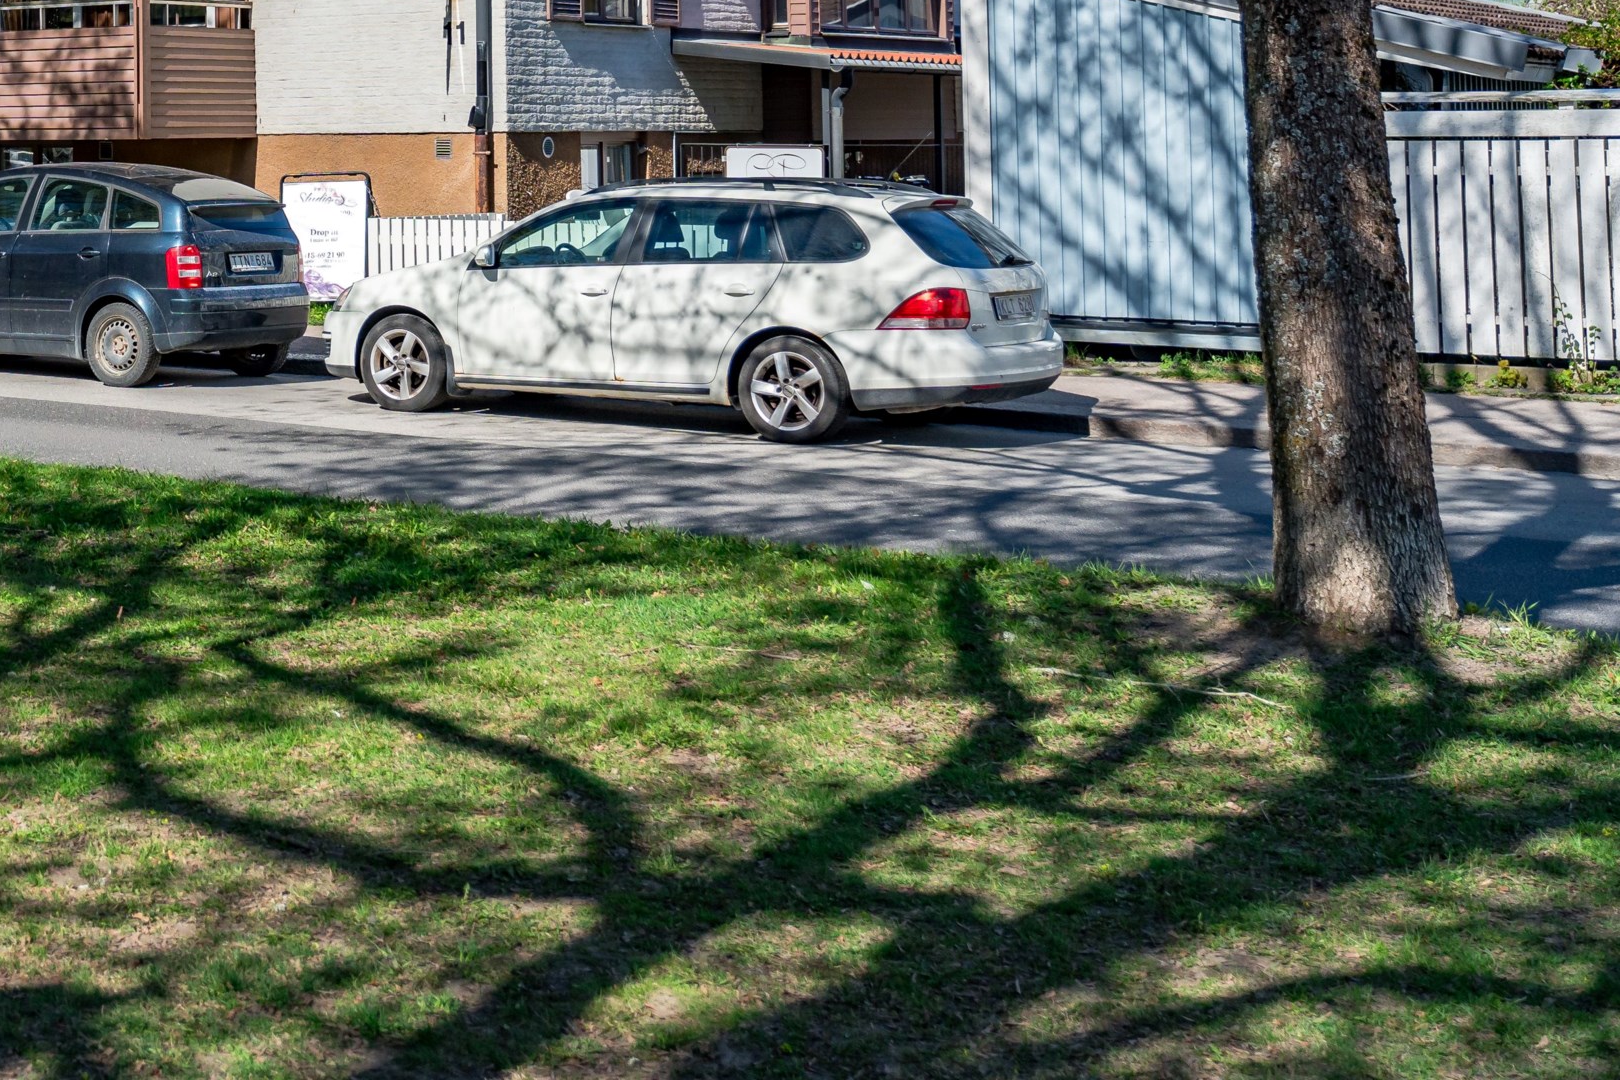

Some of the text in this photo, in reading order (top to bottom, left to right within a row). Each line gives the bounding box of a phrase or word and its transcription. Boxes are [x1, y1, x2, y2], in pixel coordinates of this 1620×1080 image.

[310, 228, 329, 237] Drop
[231, 254, 272, 266] TTN 684
[326, 251, 335, 259] 21
[999, 298, 1015, 314] KLT
